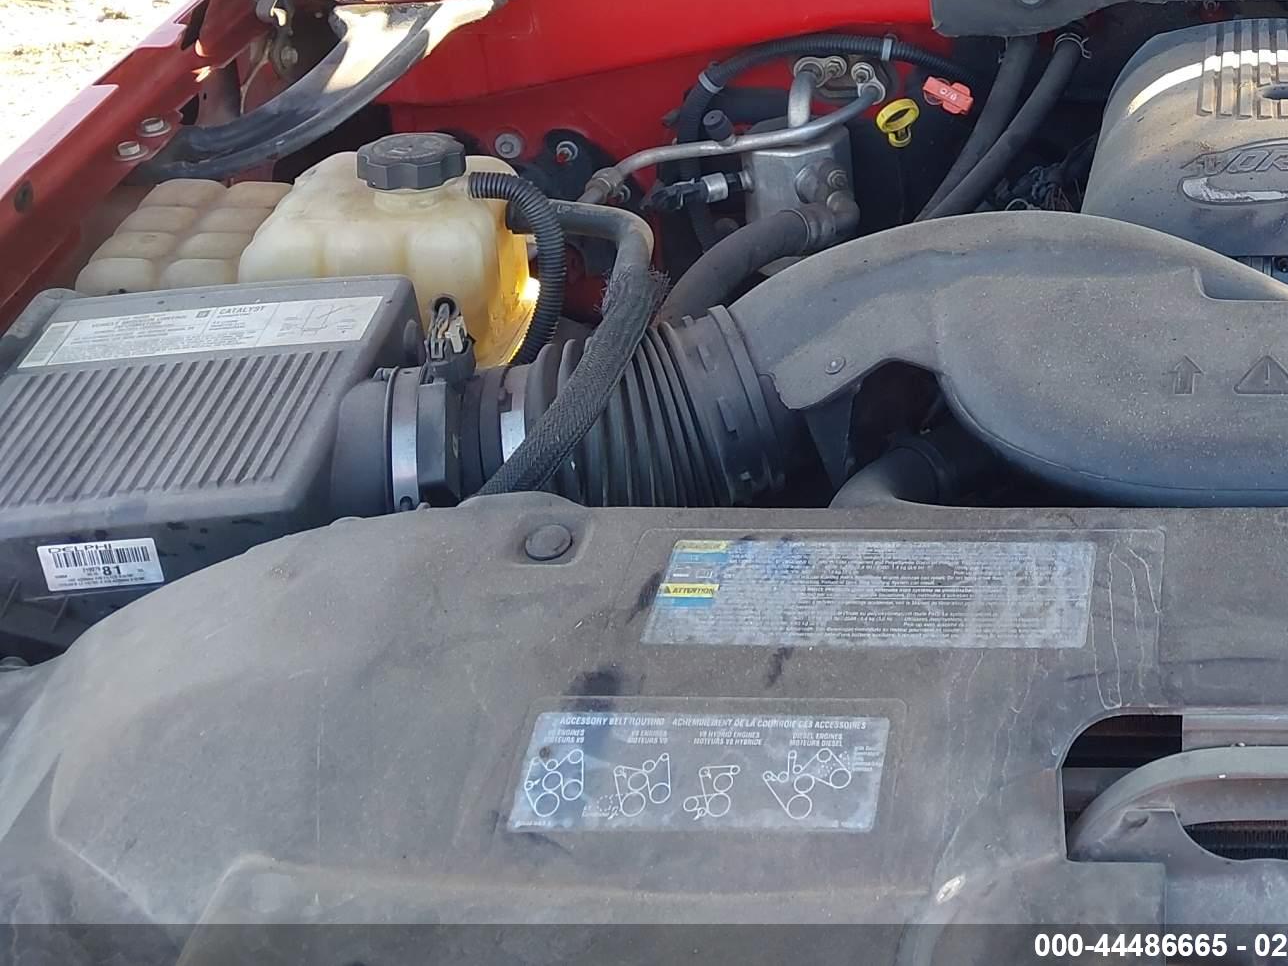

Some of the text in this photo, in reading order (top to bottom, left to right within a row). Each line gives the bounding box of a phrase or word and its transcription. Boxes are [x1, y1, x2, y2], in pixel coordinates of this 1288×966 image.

[219, 305, 265, 315] CATALYST
[48, 543, 112, 554] DELPHI
[102, 565, 122, 576] 81
[672, 586, 714, 595] ATTENTION
[560, 716, 608, 726] ACCESSORY
[609, 716, 629, 726] BELT
